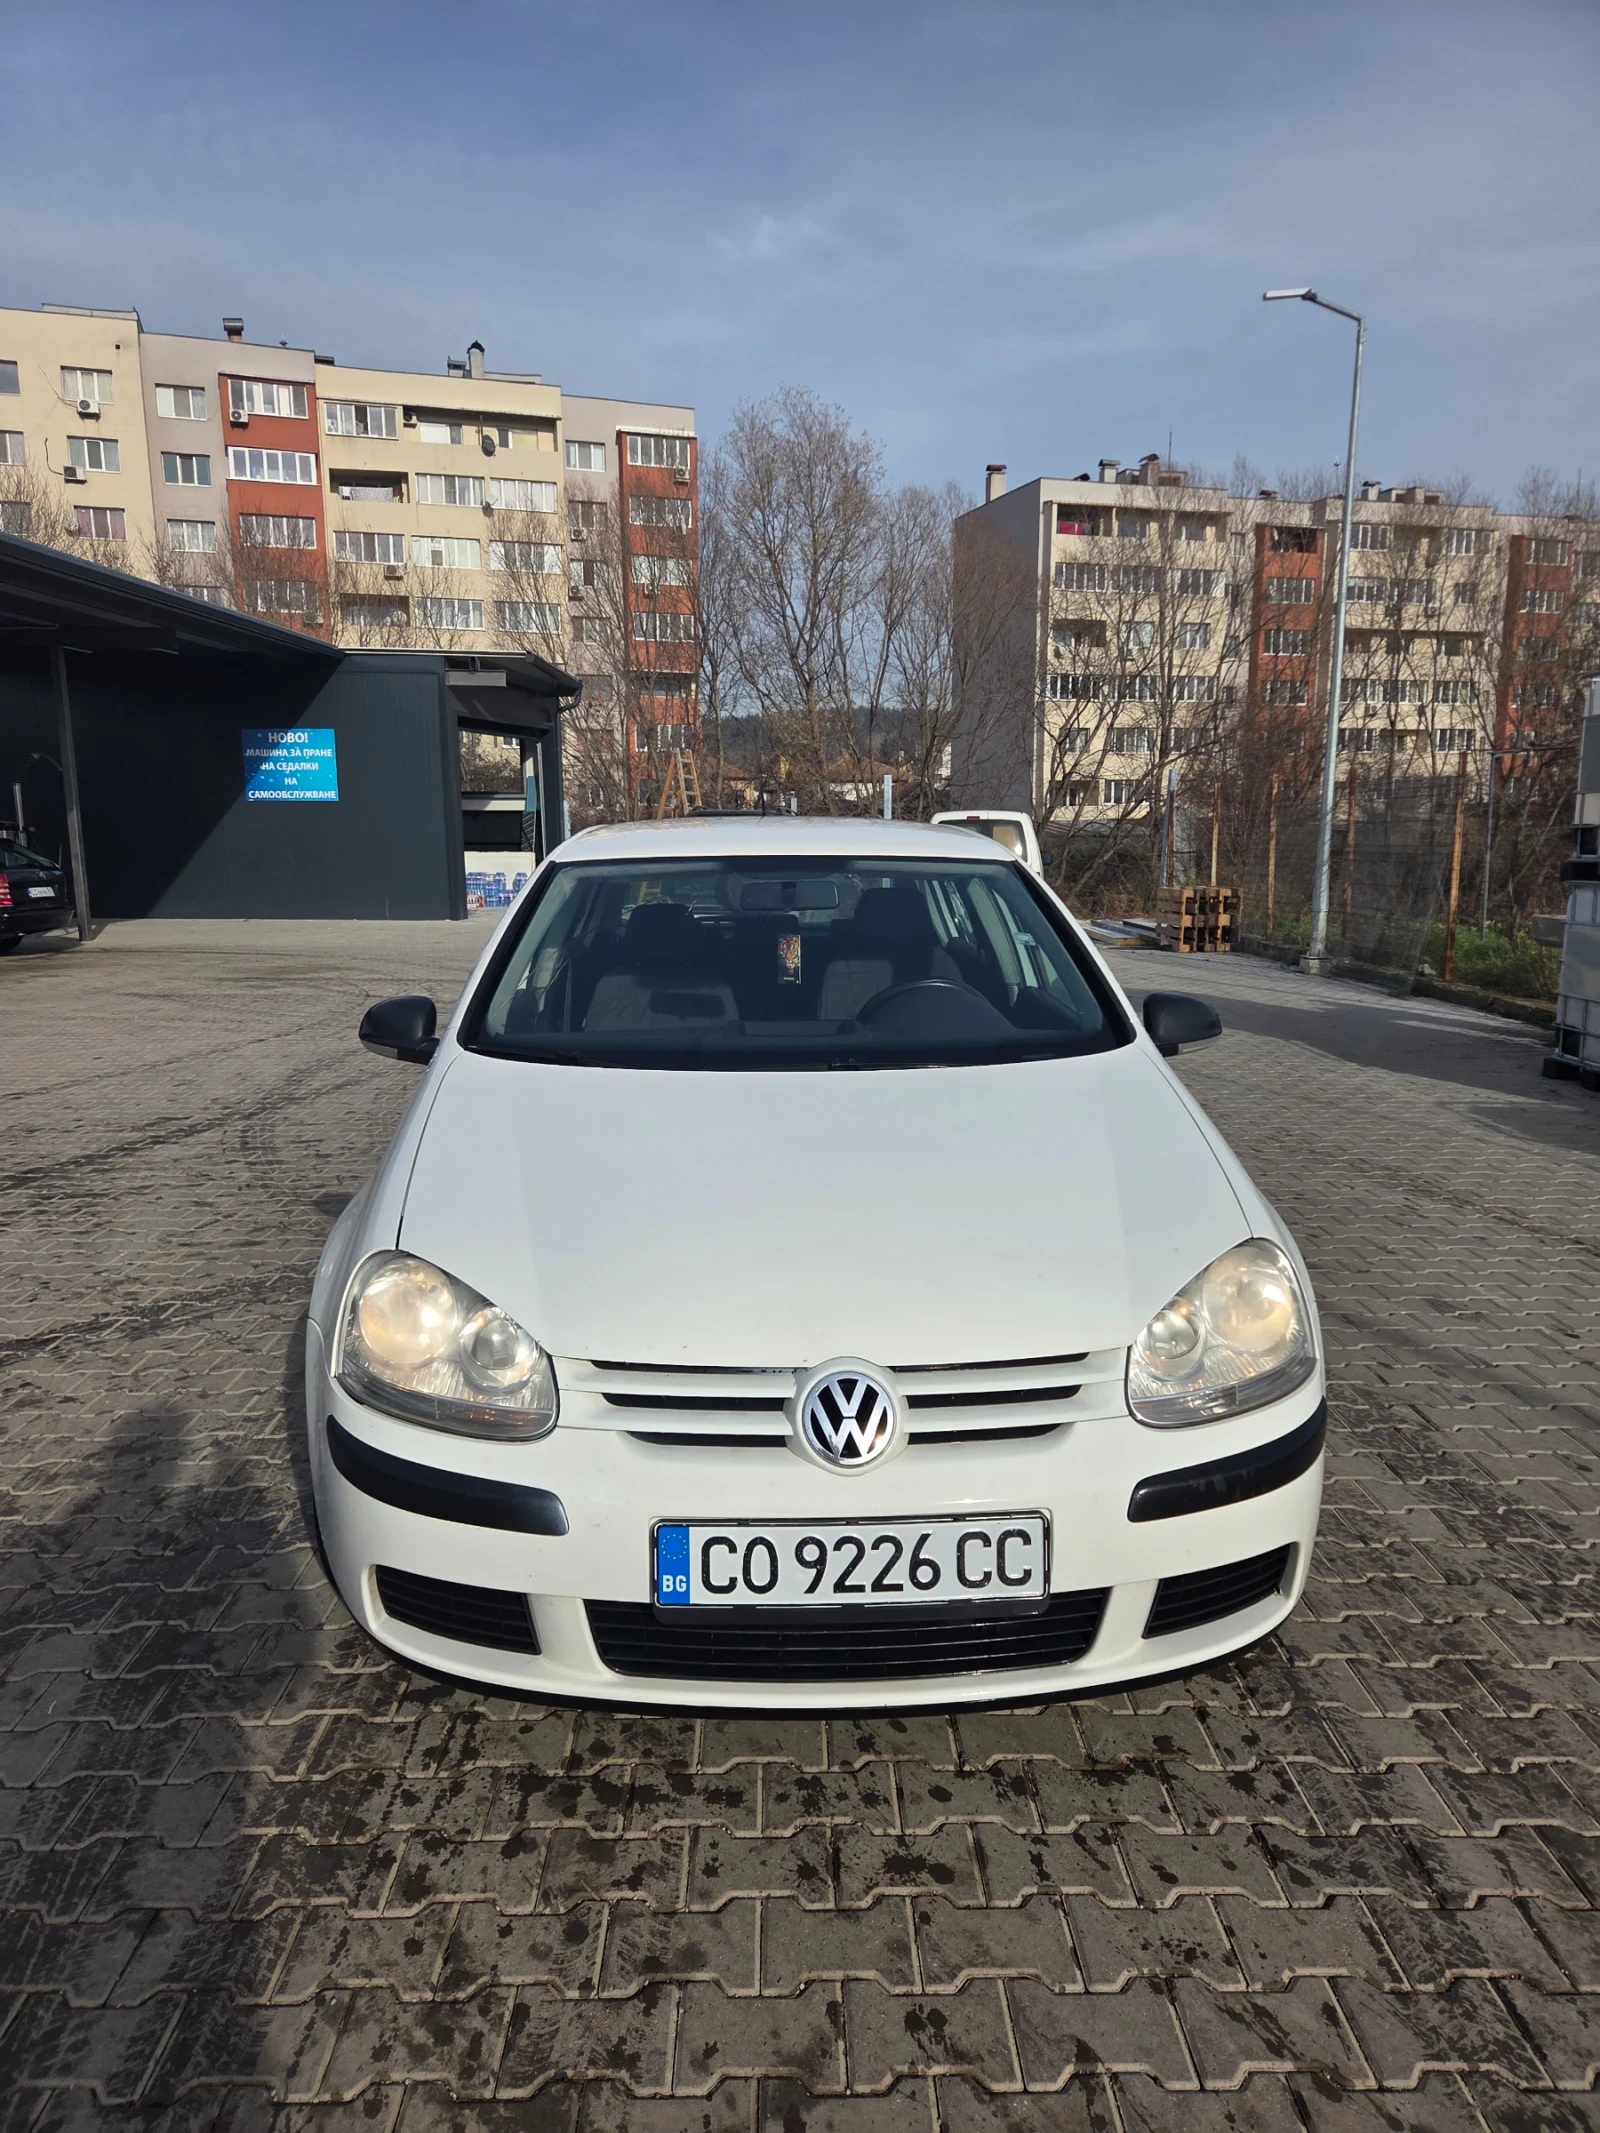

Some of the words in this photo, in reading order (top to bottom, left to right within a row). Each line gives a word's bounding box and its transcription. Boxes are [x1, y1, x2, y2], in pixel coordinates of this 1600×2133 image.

[268, 732, 308, 743] НОВО!
[246, 748, 288, 757] МАШИНА
[290, 748, 302, 757] ЗА
[303, 748, 332, 757] ПРАНЕ
[262, 762, 276, 771] НА
[276, 762, 319, 772] СЕДАЛКИ
[284, 777, 298, 786] НА
[248, 790, 337, 799] САМООБСЛУЖВАНЕ
[701, 1535, 779, 1595] CO
[794, 1532, 941, 1594] 9226
[956, 1528, 1032, 1589] CC
[662, 1574, 687, 1593] BG
